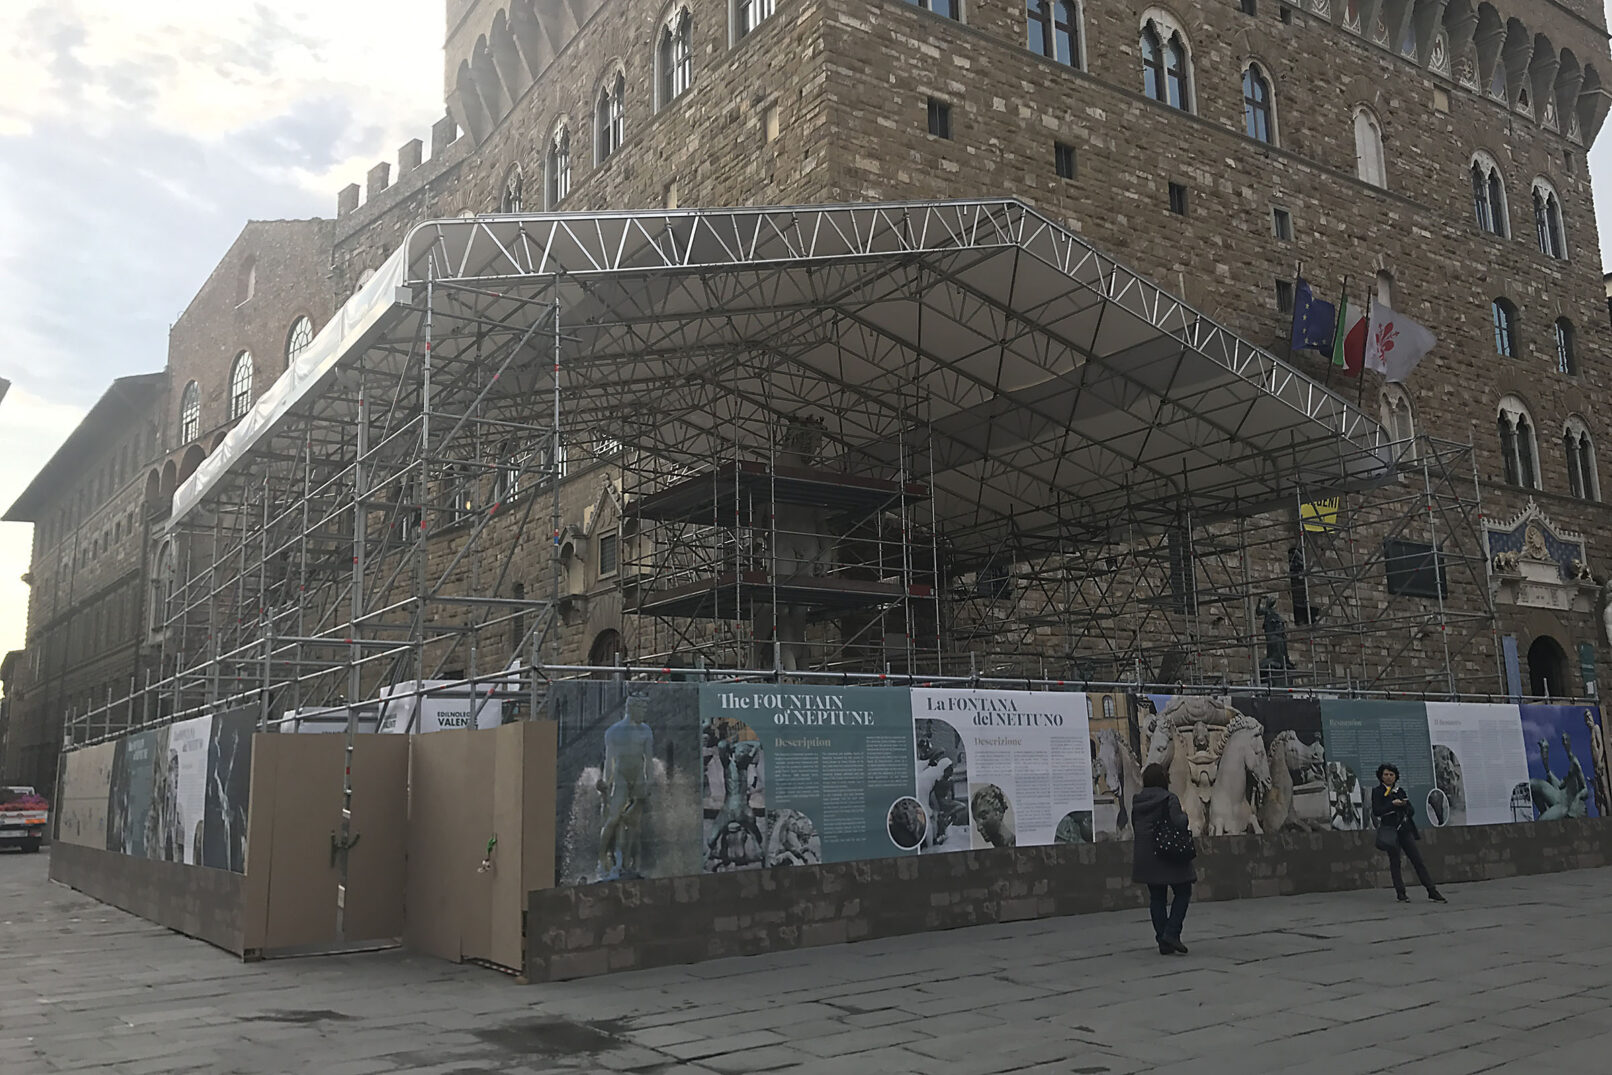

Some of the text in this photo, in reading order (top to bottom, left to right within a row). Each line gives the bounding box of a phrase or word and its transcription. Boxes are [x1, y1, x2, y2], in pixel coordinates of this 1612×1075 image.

[717, 693, 843, 710] The FOUNTAIN
[927, 697, 1017, 712] La FONTANA
[774, 709, 875, 725] of NEPTUNE
[973, 712, 1063, 727] del NETTUNO
[775, 737, 831, 749] Description
[974, 737, 1023, 746] Descrizione
